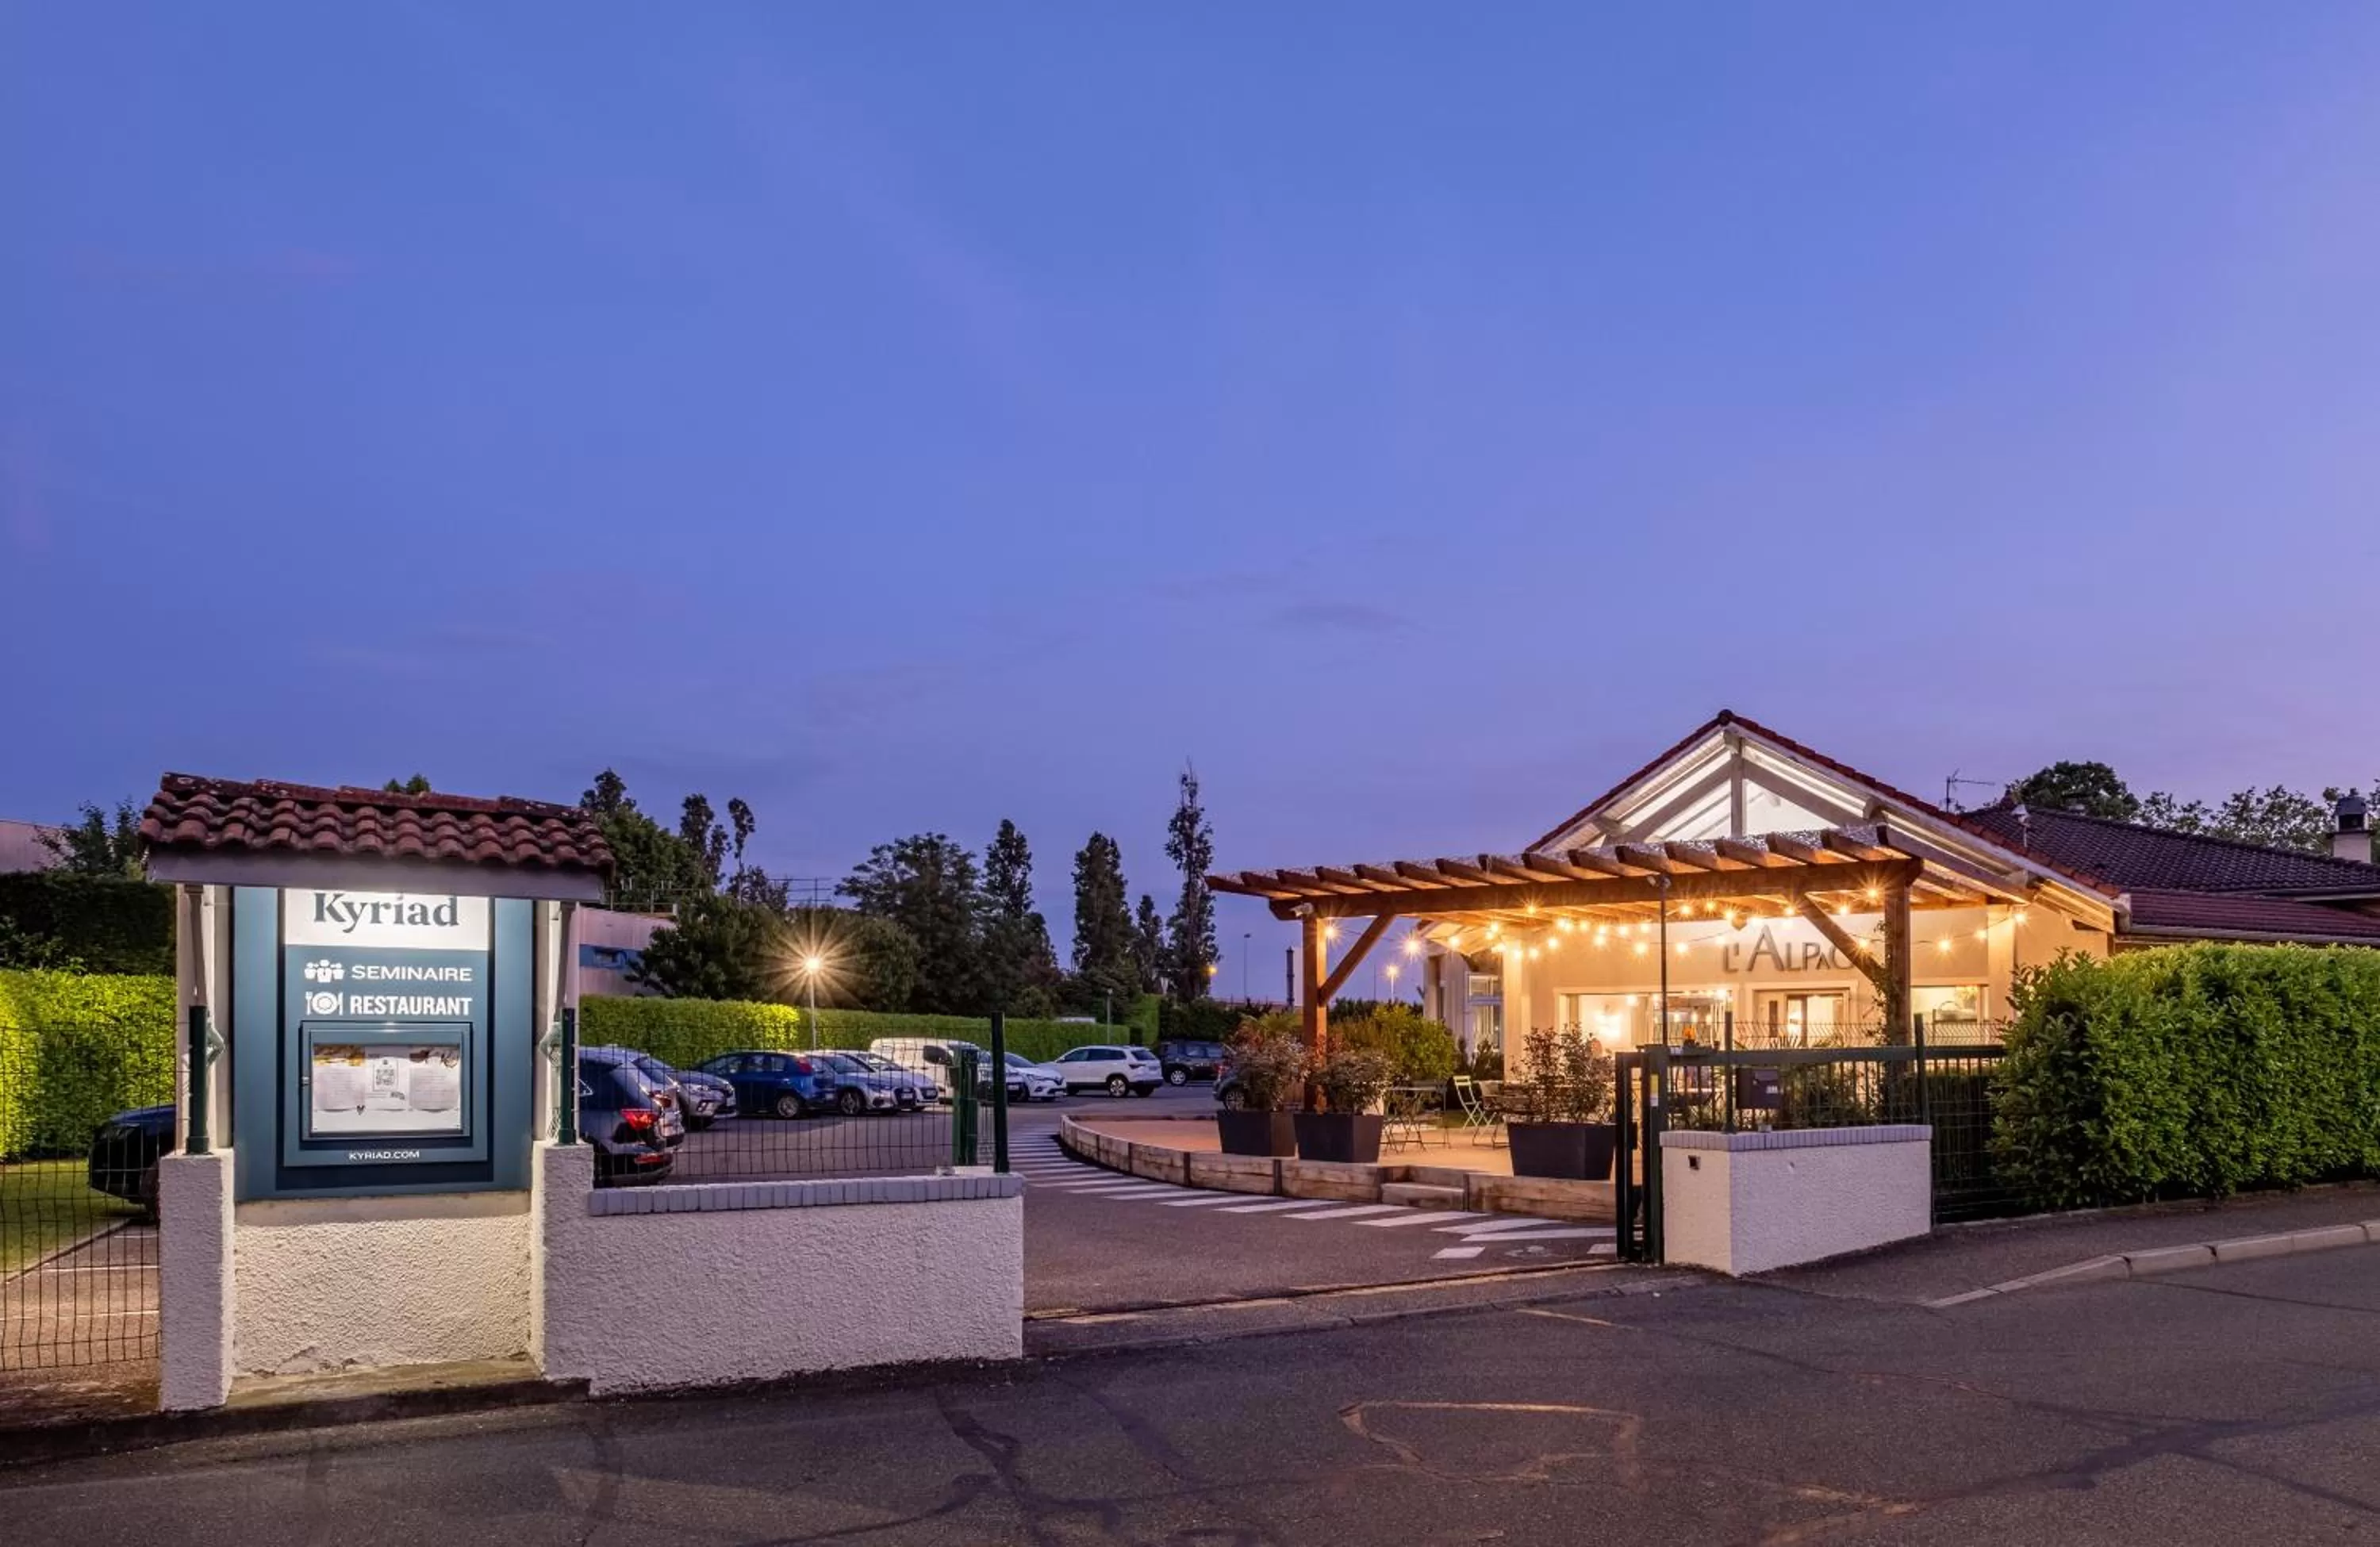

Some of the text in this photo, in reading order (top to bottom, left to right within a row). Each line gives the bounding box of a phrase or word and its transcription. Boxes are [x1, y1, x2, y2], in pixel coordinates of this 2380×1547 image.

[313, 892, 459, 933] Kyriad
[351, 965, 473, 981] SEMINAIRE
[350, 995, 473, 1015] RESTAURANT
[349, 1150, 420, 1160] KYRIAD.COM
